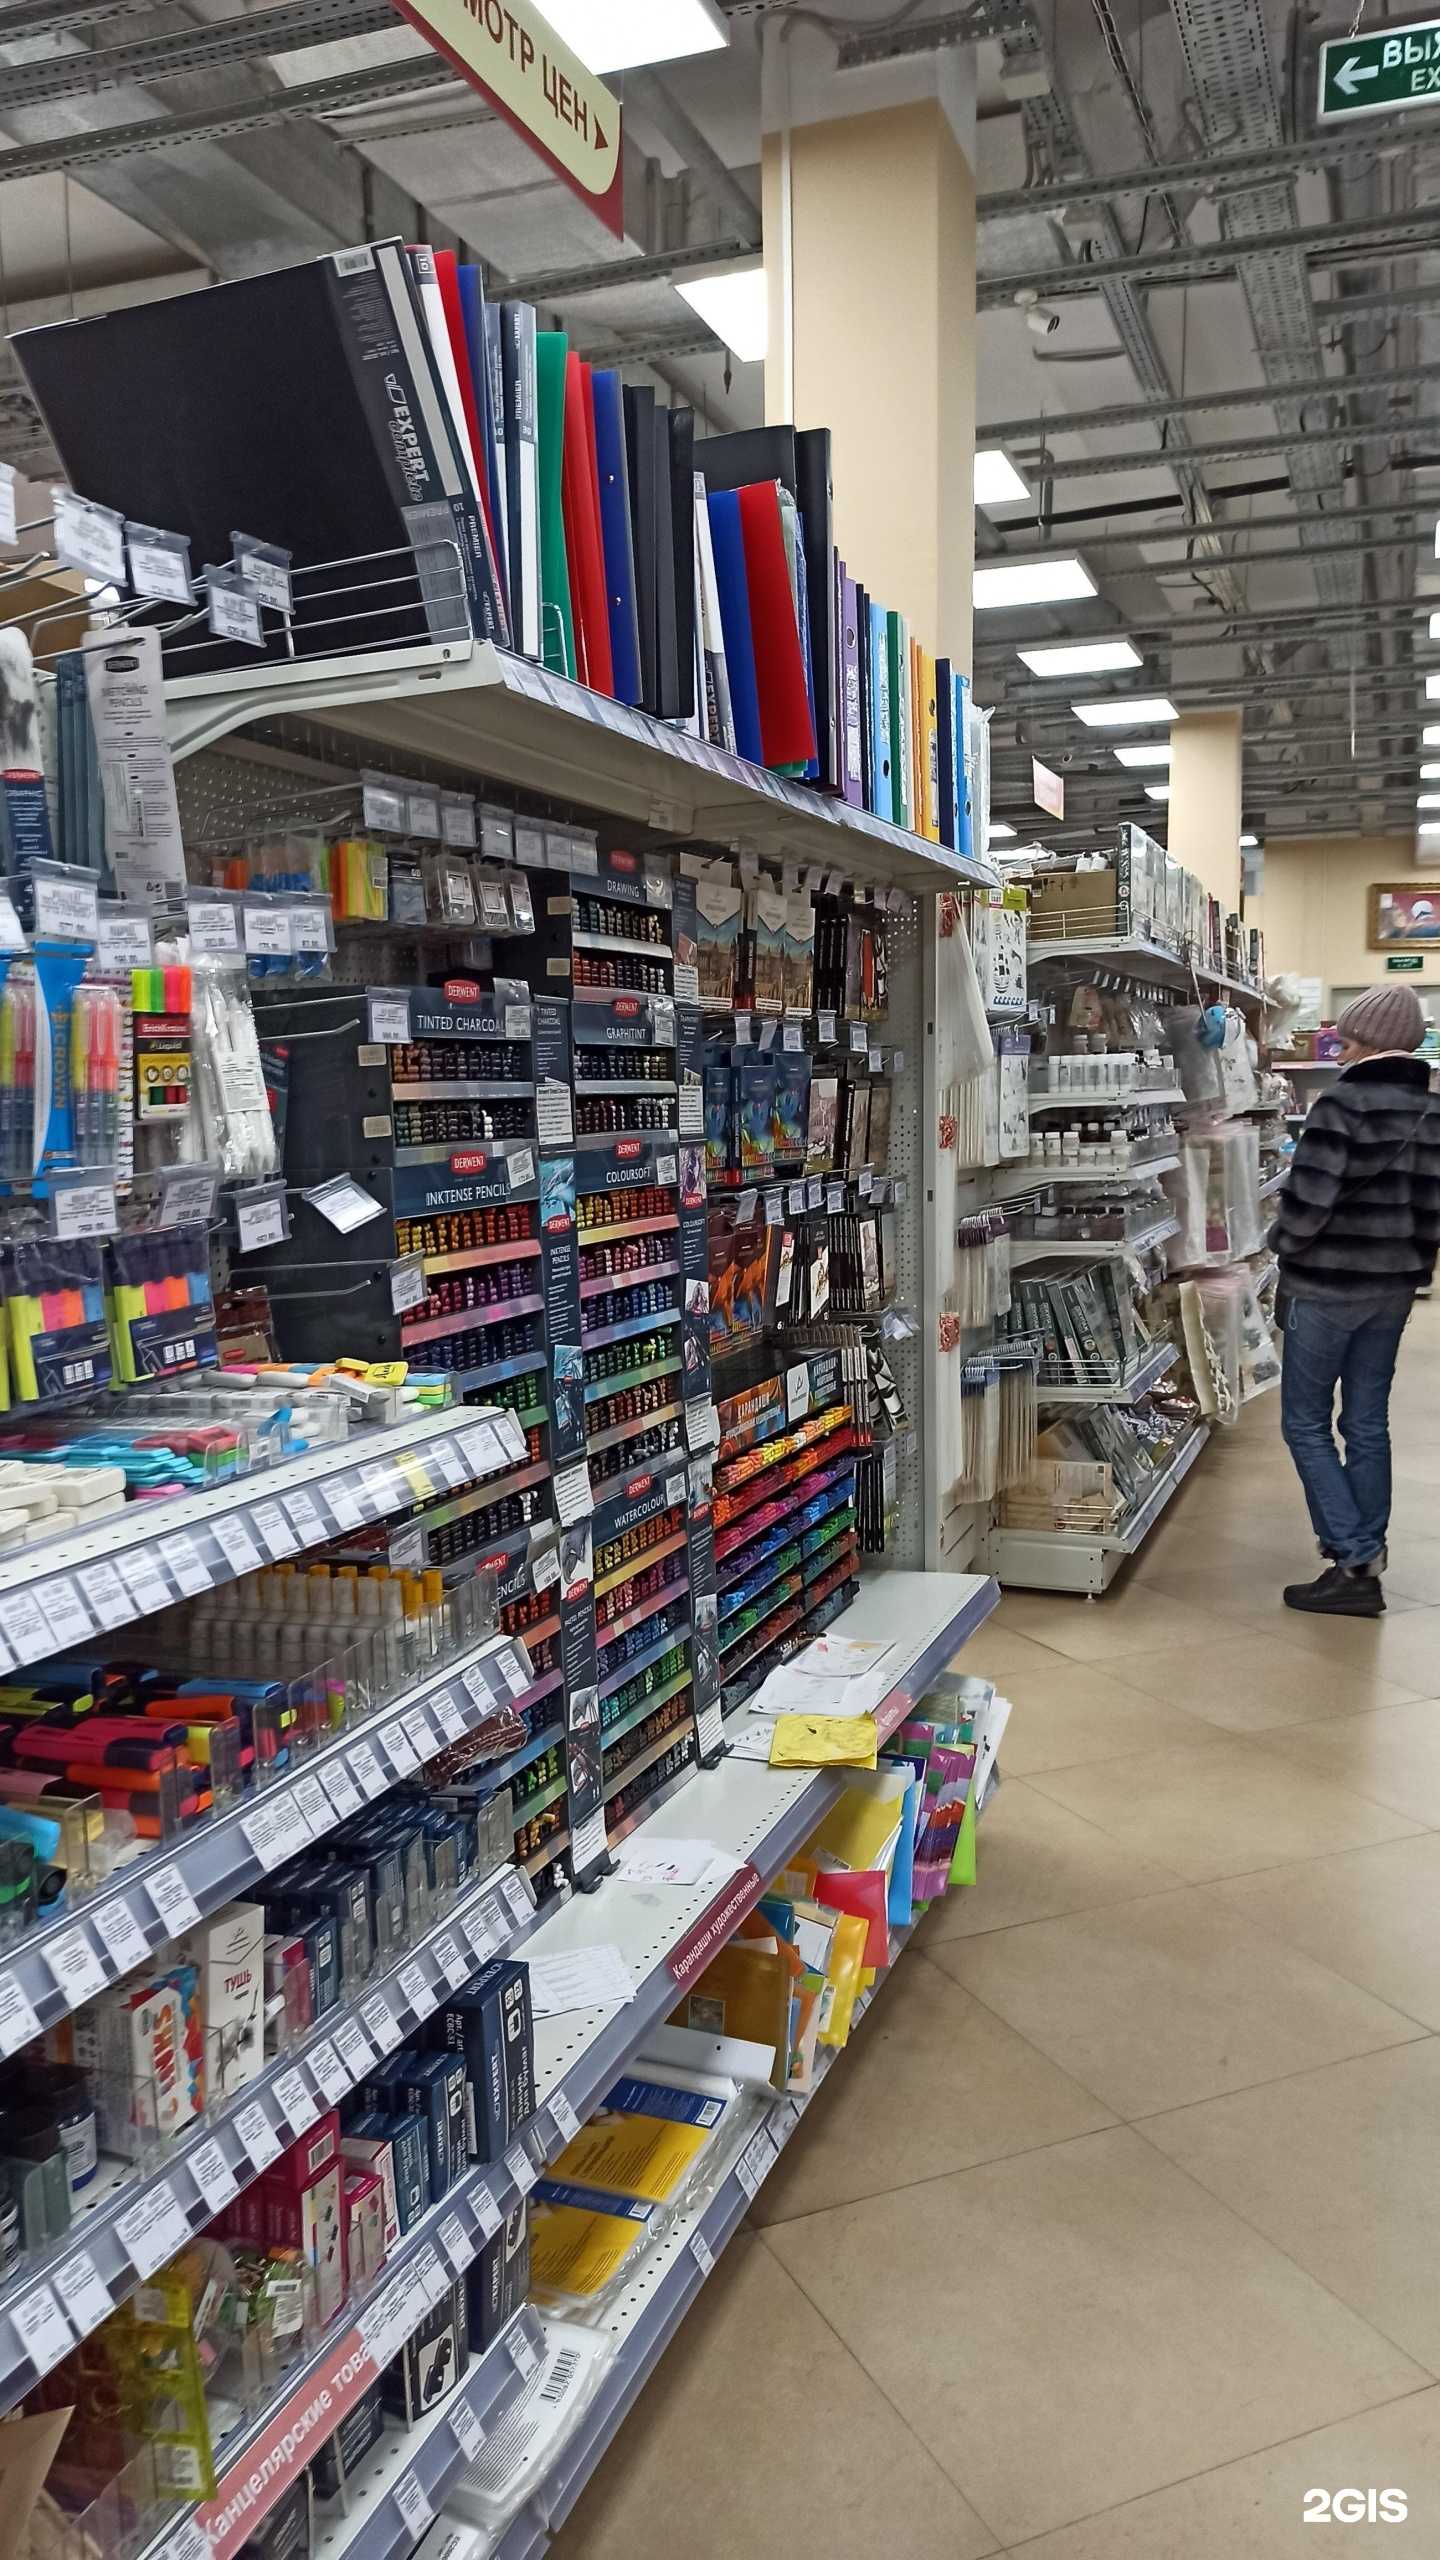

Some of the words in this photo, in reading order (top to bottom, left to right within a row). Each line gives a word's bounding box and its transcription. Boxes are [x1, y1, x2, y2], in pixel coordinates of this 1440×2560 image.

[542, 53, 588, 142] ЦЕН
[514, 380, 522, 420] PREMIER
[393, 405, 430, 481] EXPERT
[468, 514, 482, 558] PREMIER
[484, 598, 495, 630] EXPERT
[607, 879, 640, 898] DRAWING
[448, 985, 478, 999] DERWENT
[616, 1003, 638, 1013] DERWENT
[417, 1015, 453, 1030] TINTED
[606, 1027, 647, 1041] GRAPHITINT
[617, 1142, 641, 1156] DERWENT
[454, 1156, 484, 1169] DERWENT
[606, 1167, 652, 1184] COLOURSOFT
[426, 1190, 473, 1206] INKTENSE
[476, 1183, 511, 1200] PENCILS
[549, 1218, 571, 1230] DERWENT
[628, 1476, 651, 1494] DERWENT
[614, 1493, 666, 1529] WATERCOLOUR
[567, 1582, 589, 1600] DERWENT
[672, 1932, 712, 1979] Карандаши
[710, 1873, 760, 1936] художественные
[224, 1969, 252, 1994] ТУШЬ
[466, 1967, 498, 1995] EXPERT
[491, 2053, 500, 2102] EXPERT
[204, 2389, 333, 2544] Канцелярские
